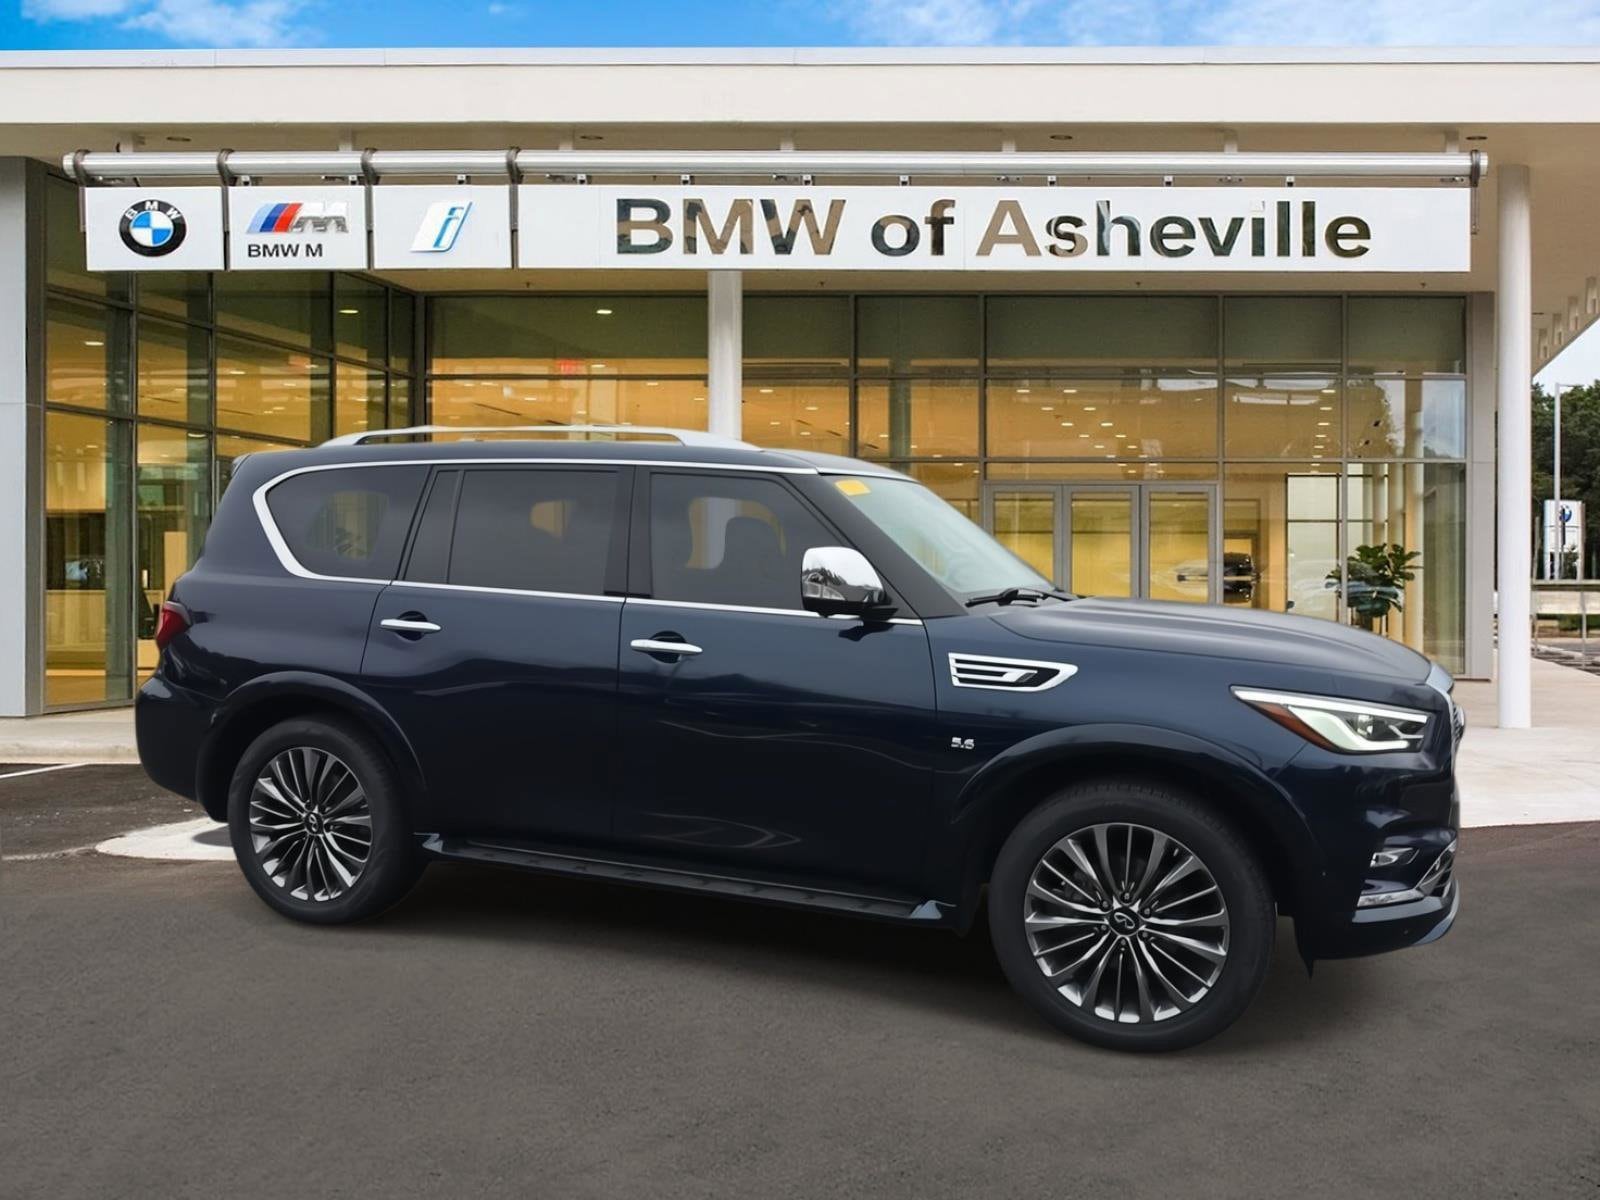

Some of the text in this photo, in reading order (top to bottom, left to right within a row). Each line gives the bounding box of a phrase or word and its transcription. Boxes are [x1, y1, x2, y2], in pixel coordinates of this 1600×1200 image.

[125, 201, 181, 220] BMW
[616, 198, 1372, 258] BMW of Asheville
[247, 243, 323, 258] BMW M
